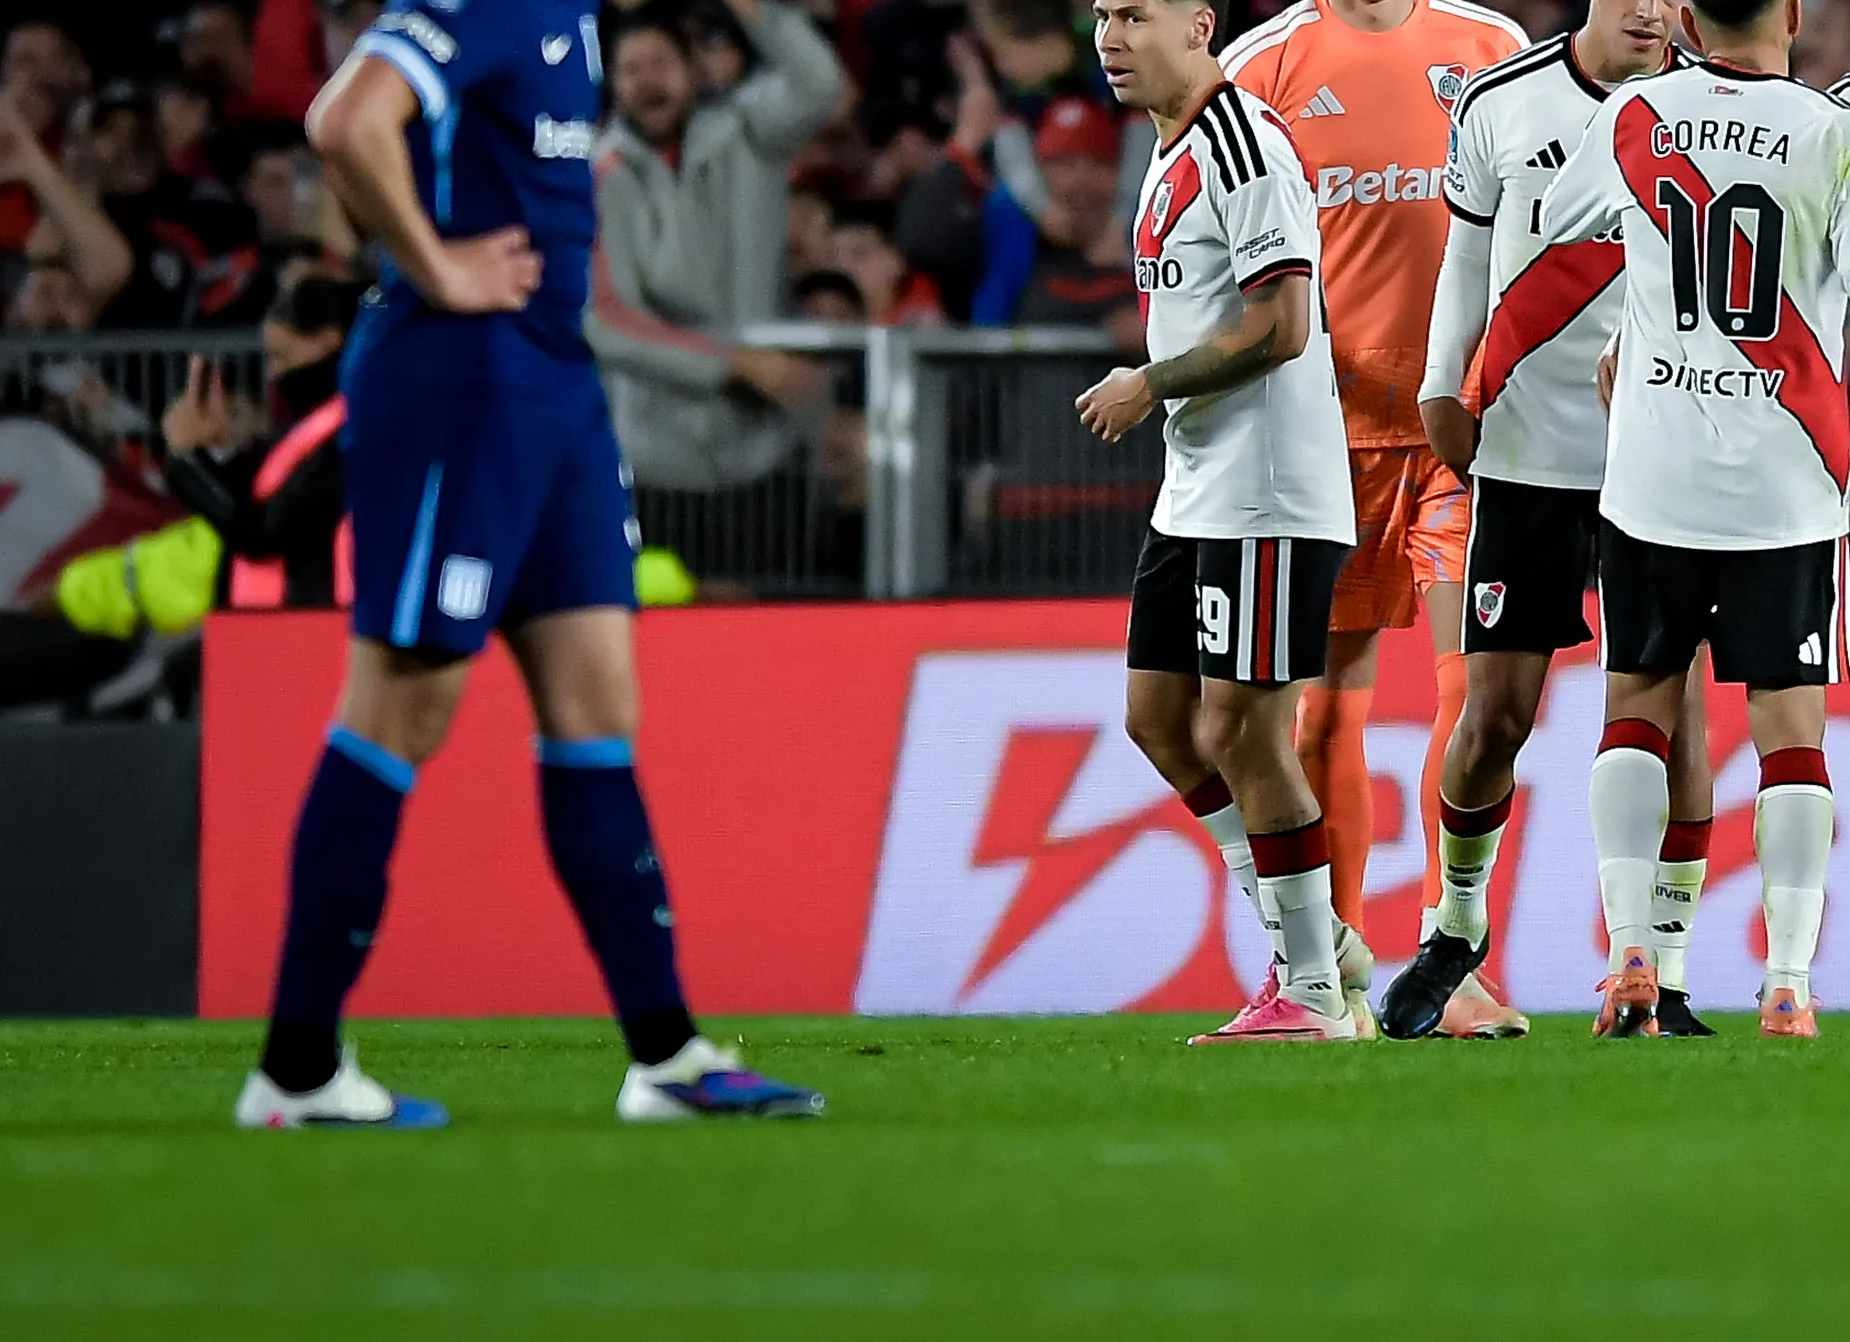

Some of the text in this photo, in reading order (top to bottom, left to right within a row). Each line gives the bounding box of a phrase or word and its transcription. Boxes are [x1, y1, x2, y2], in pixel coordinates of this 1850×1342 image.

[1651, 119, 1792, 166] CORREA
[1655, 176, 1785, 342] 10
[1645, 355, 1785, 400] DIRECTV
[1195, 583, 1231, 655] 9
